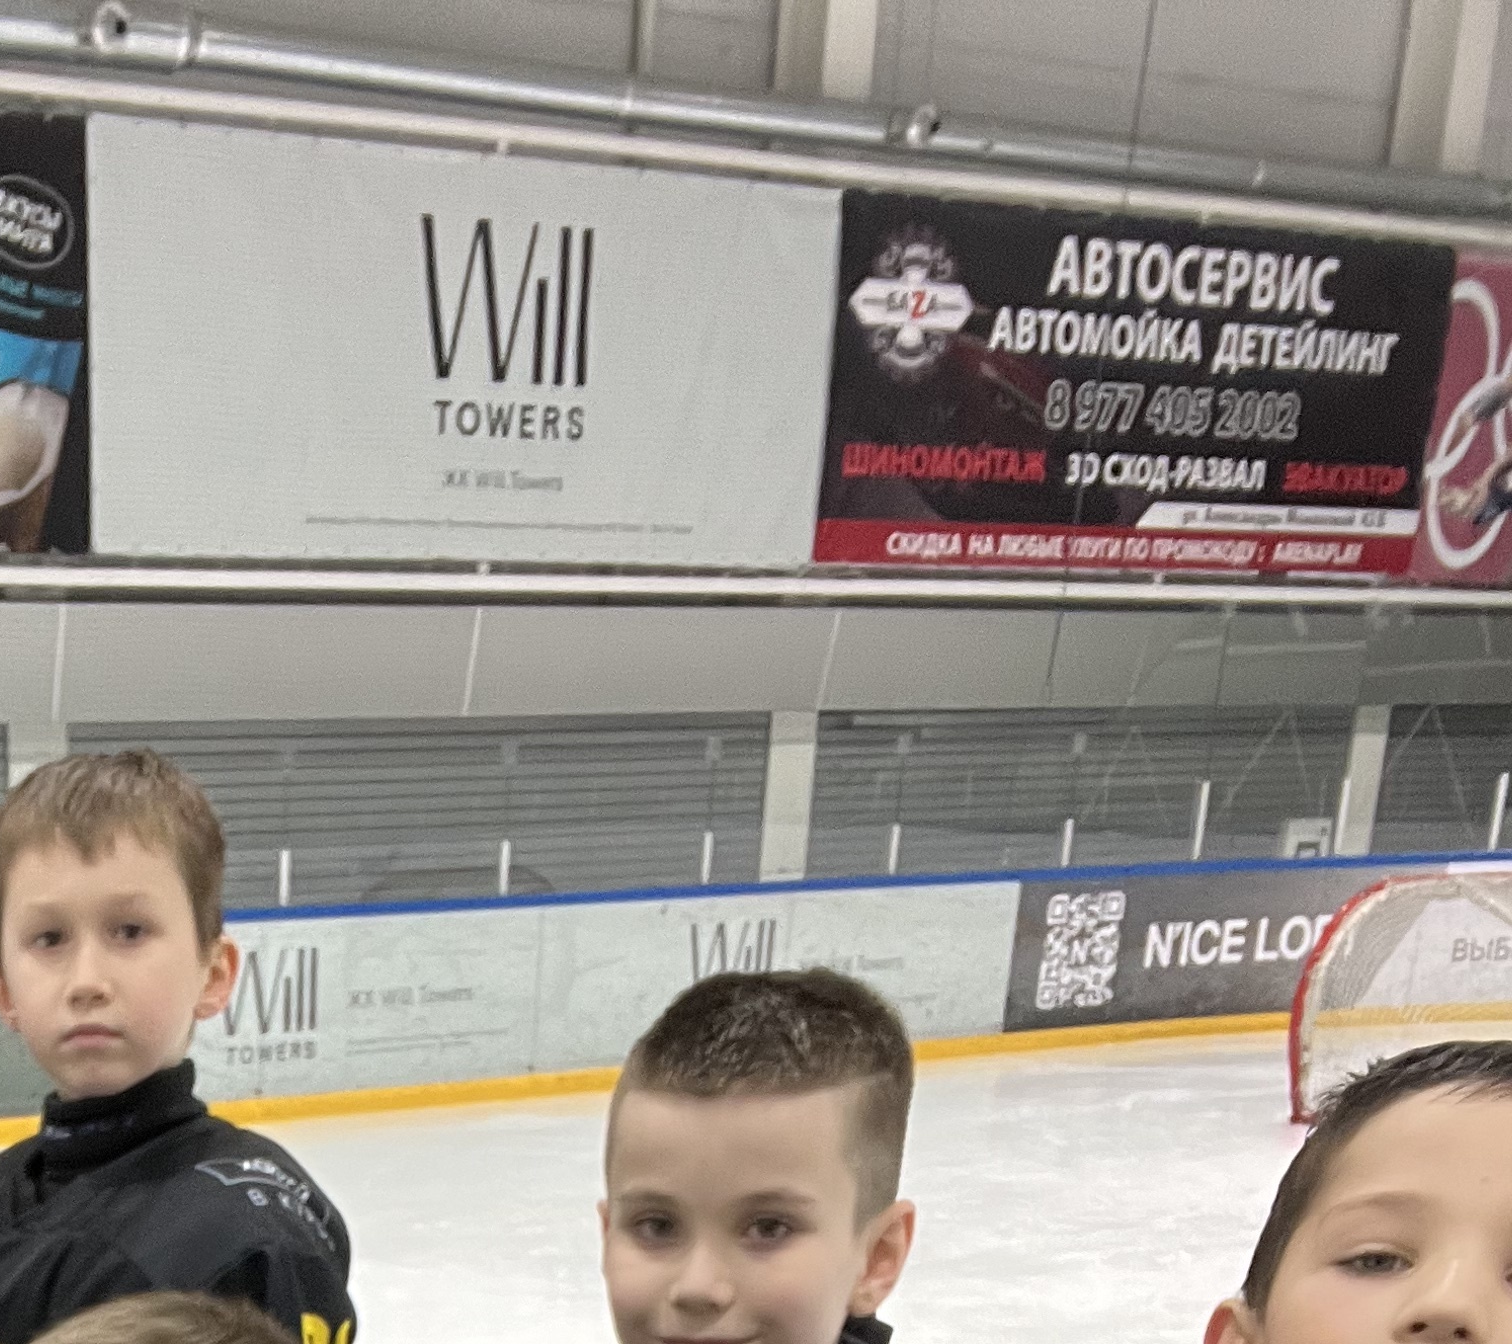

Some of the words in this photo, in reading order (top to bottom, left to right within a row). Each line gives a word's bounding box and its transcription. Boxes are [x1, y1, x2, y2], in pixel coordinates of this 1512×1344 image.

[420, 212, 595, 387] Will
[1046, 234, 1341, 317] АВТОСЕРВИС
[988, 305, 1203, 364] АВТОМОЙКА
[1210, 319, 1400, 375] ДЕТЕЙЛИНГ
[433, 399, 585, 441] TOWERS
[1043, 379, 1073, 431] 8
[1074, 381, 1146, 434] 977
[1143, 919, 1250, 969] NICE
[1452, 935, 1512, 962] ВЫБ
